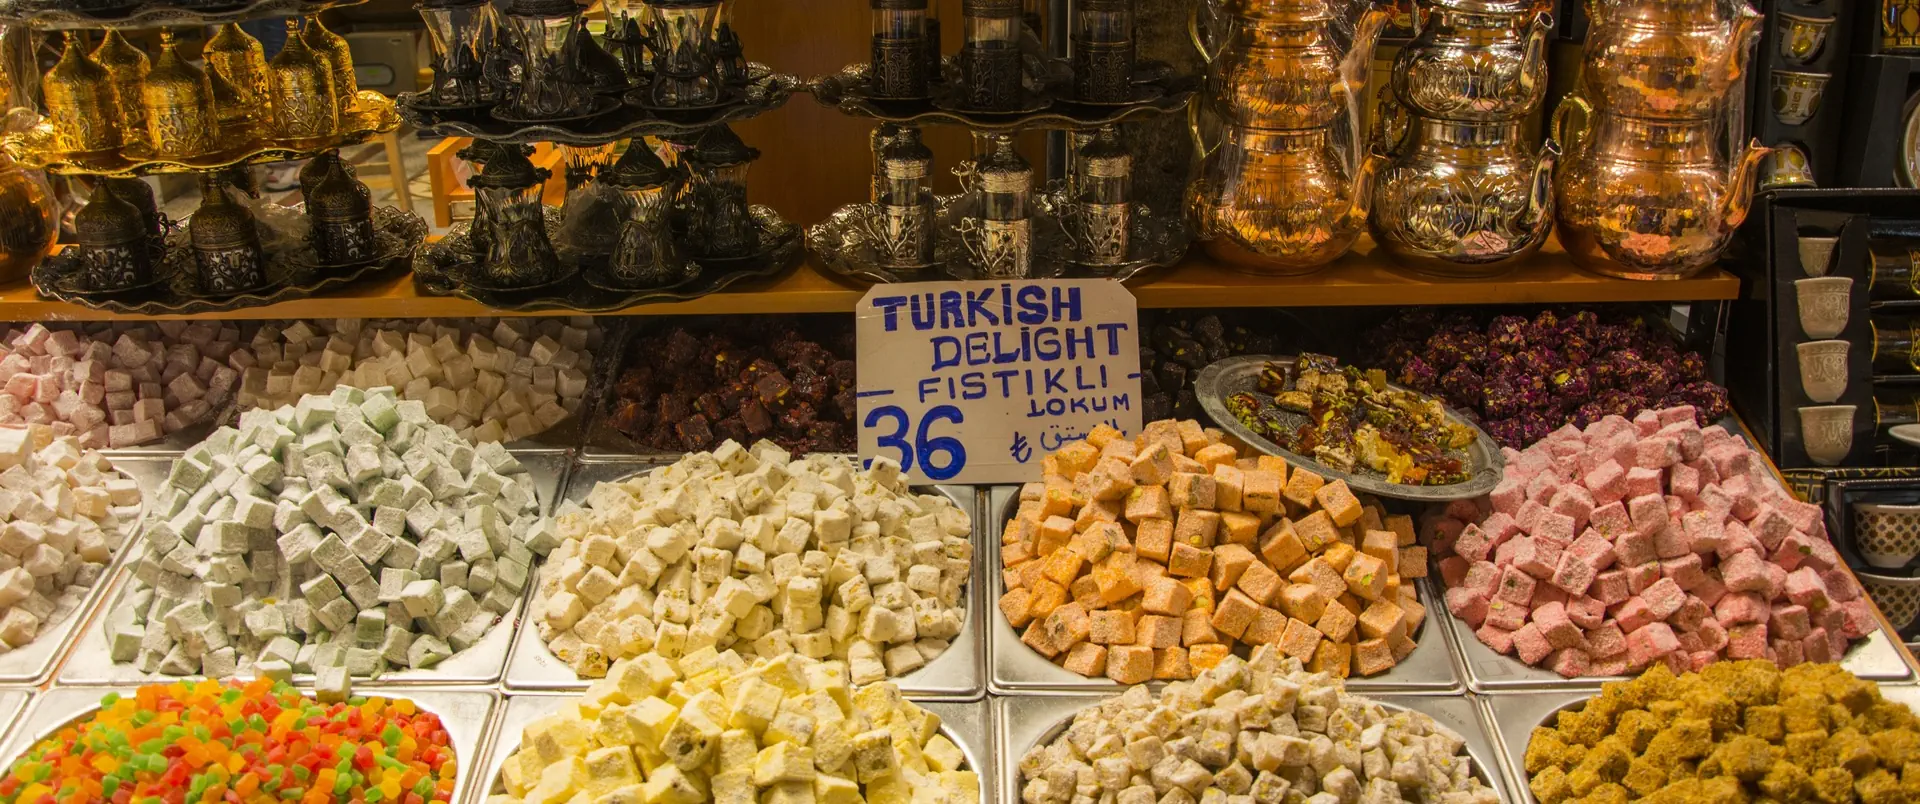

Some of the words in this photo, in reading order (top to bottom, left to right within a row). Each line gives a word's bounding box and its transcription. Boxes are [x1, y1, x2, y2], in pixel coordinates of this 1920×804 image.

[918, 364, 1109, 403] FISTIKLI
[1027, 393, 1130, 417] LOKUM
[863, 404, 967, 480] 36
